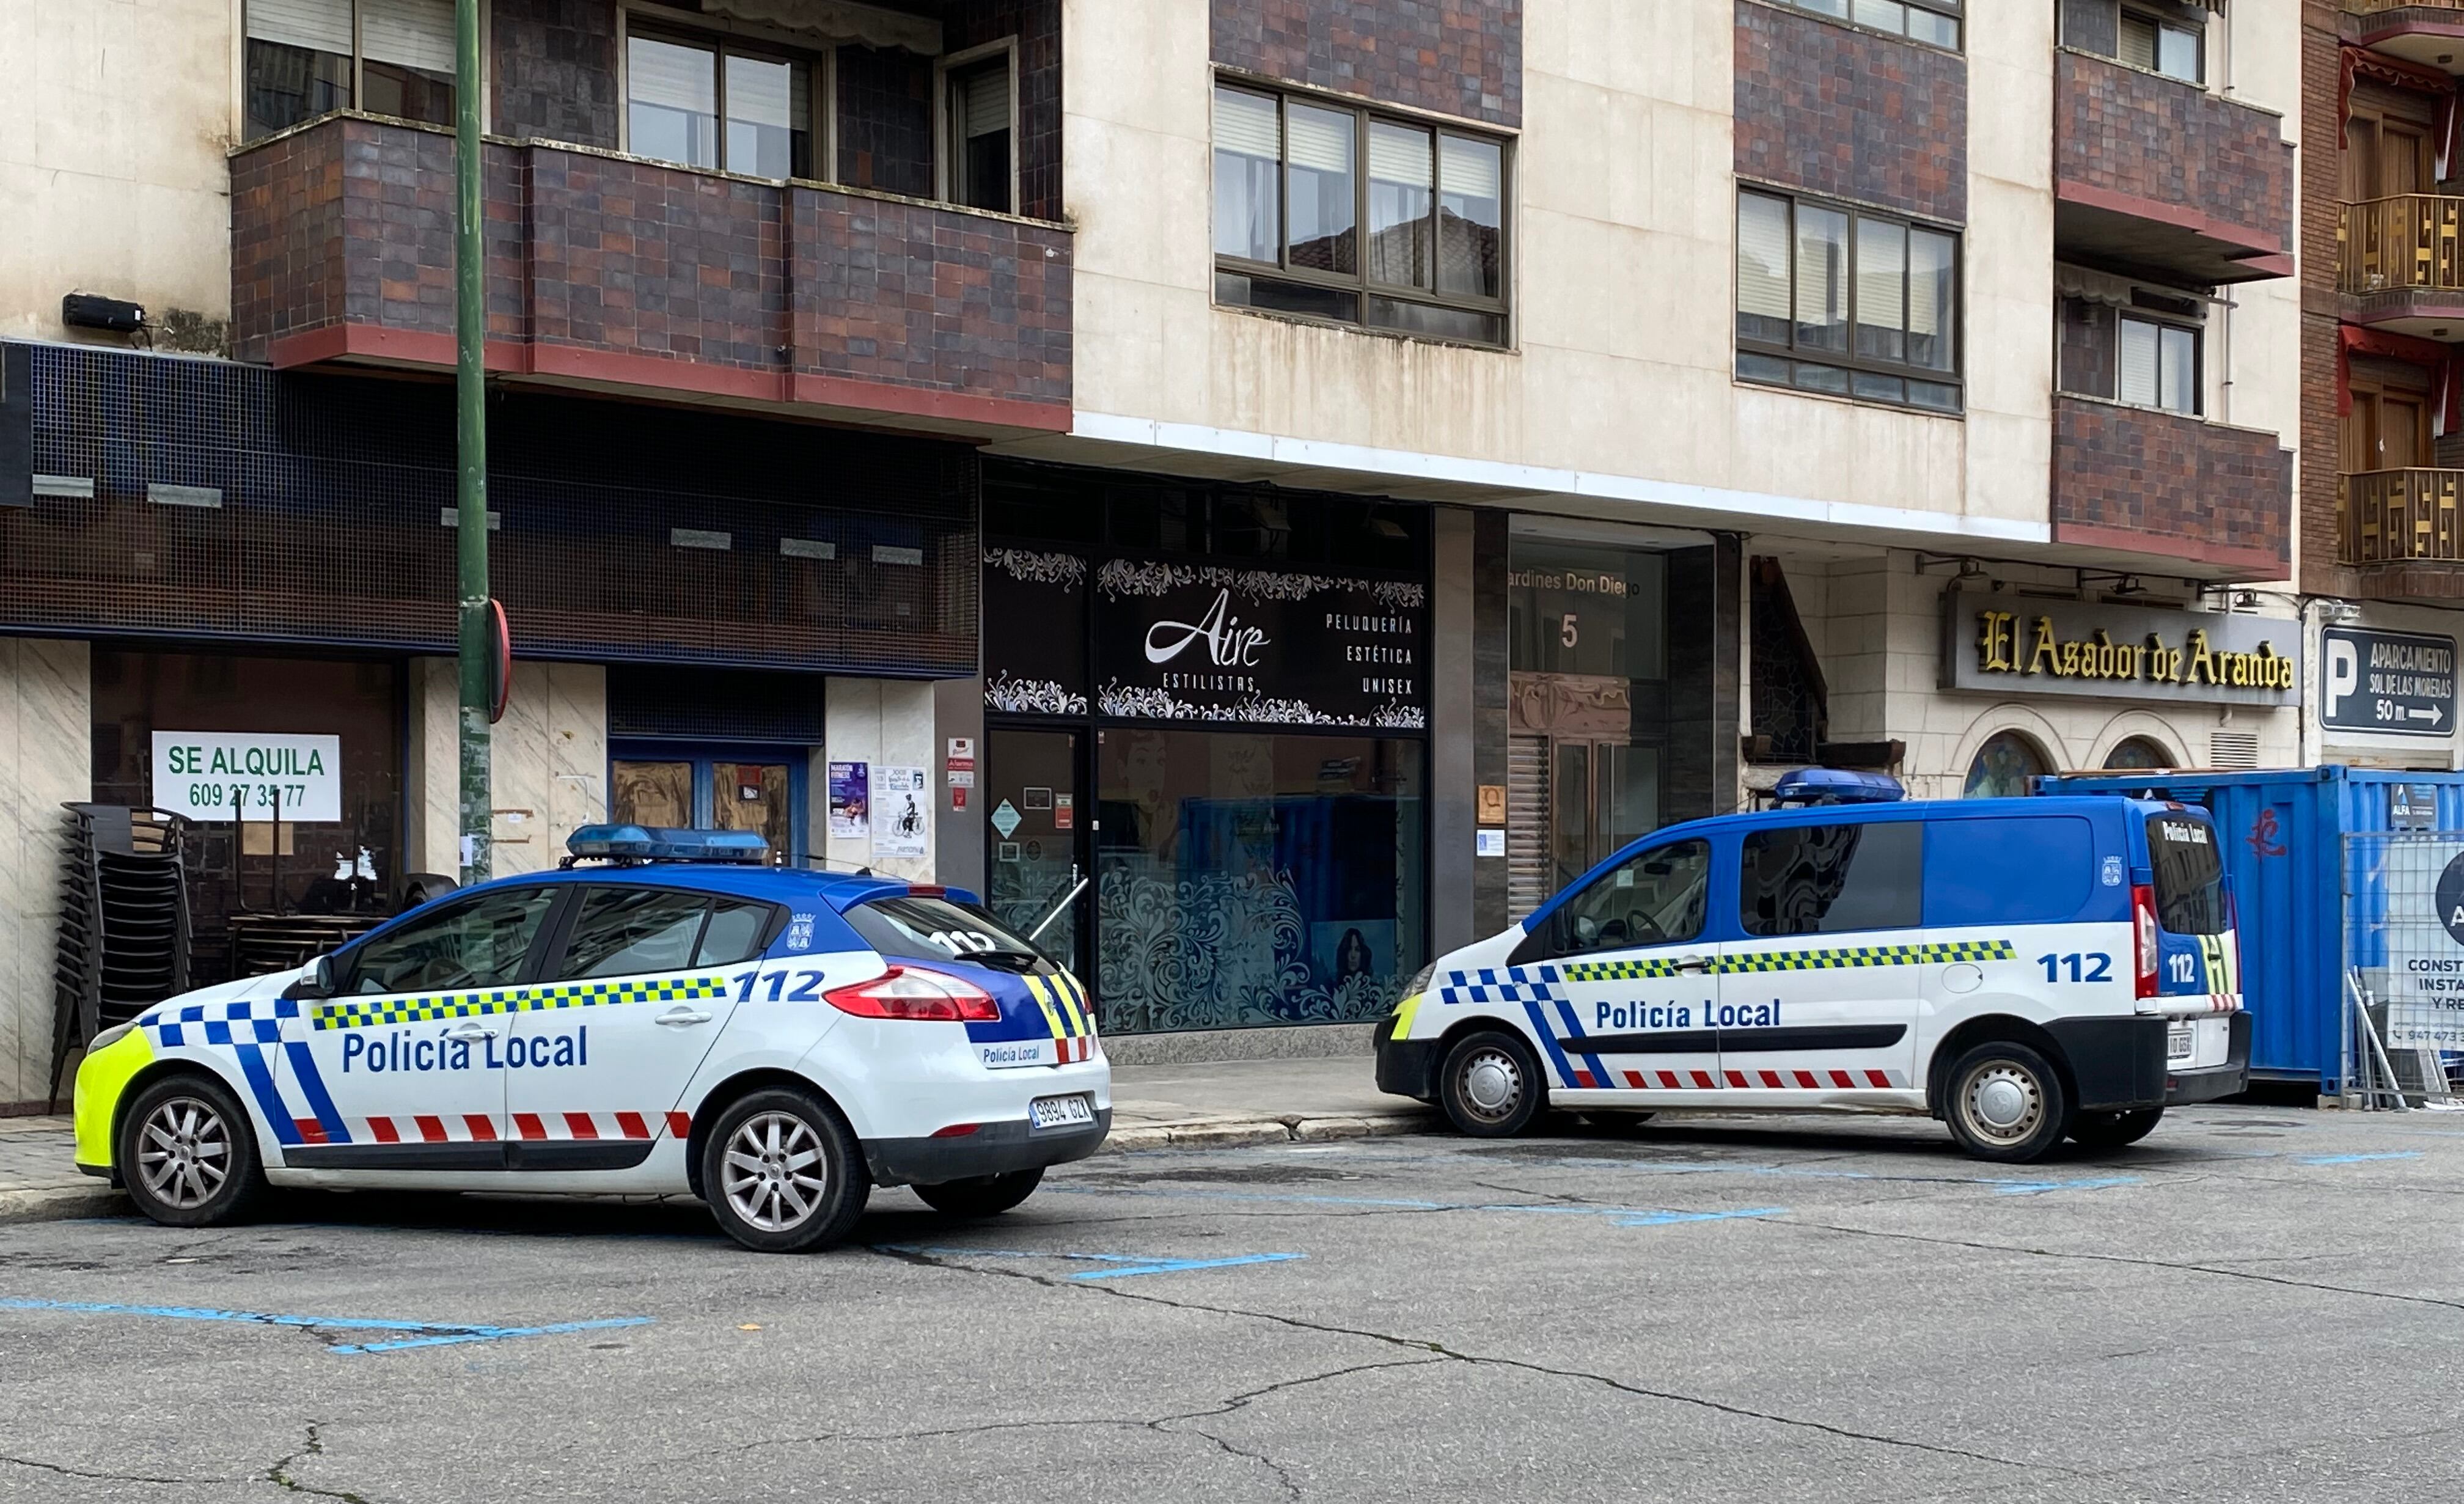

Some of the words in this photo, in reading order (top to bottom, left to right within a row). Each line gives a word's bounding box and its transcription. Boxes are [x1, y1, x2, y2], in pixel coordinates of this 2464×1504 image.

[1508, 569, 1561, 590] ardines
[1566, 572, 1596, 593] Don
[1599, 575, 1641, 600] Diego
[1145, 587, 1271, 667] Aire
[1326, 612, 1412, 634] PELUQUERÍA
[1561, 614, 1579, 648] 5
[1346, 644, 1412, 665] ESTÉTICA
[1982, 611, 2023, 672] El
[2028, 615, 2146, 680] Asador
[2148, 632, 2184, 682] de
[2188, 627, 2295, 690] Aranda
[2369, 642, 2452, 674] APARCAMIENTO
[1162, 672, 1255, 692] ESTILISTAS
[1362, 677, 1413, 695] UNISEX
[2325, 638, 2358, 717] P
[2369, 672, 2385, 694] SOL
[2386, 673, 2396, 695] DE
[2397, 674, 2413, 696] LAS
[2414, 676, 2452, 699] MORERAS
[2375, 698, 2394, 721] 50
[168, 745, 203, 775] SE
[209, 746, 326, 777] ALQUILA
[189, 782, 223, 807] 609
[229, 783, 251, 807] 27
[257, 783, 279, 807] 35
[284, 783, 306, 807] 77
[2393, 805, 2411, 816] ALFA
[2036, 952, 2113, 983] 112
[2168, 953, 2195, 983] 112
[732, 969, 826, 1003] 112
[1596, 999, 1691, 1029] Policía
[1704, 997, 1780, 1027] Local
[2432, 997, 2442, 1010] Y
[343, 1027, 471, 1073] Policía
[485, 1024, 587, 1069] Local
[2408, 1030, 2431, 1041] 947
[983, 1046, 1016, 1063] Policía
[1018, 1044, 1040, 1061] Local
[1036, 1099, 1066, 1123] 9894
[1068, 1099, 1090, 1120] GZX
